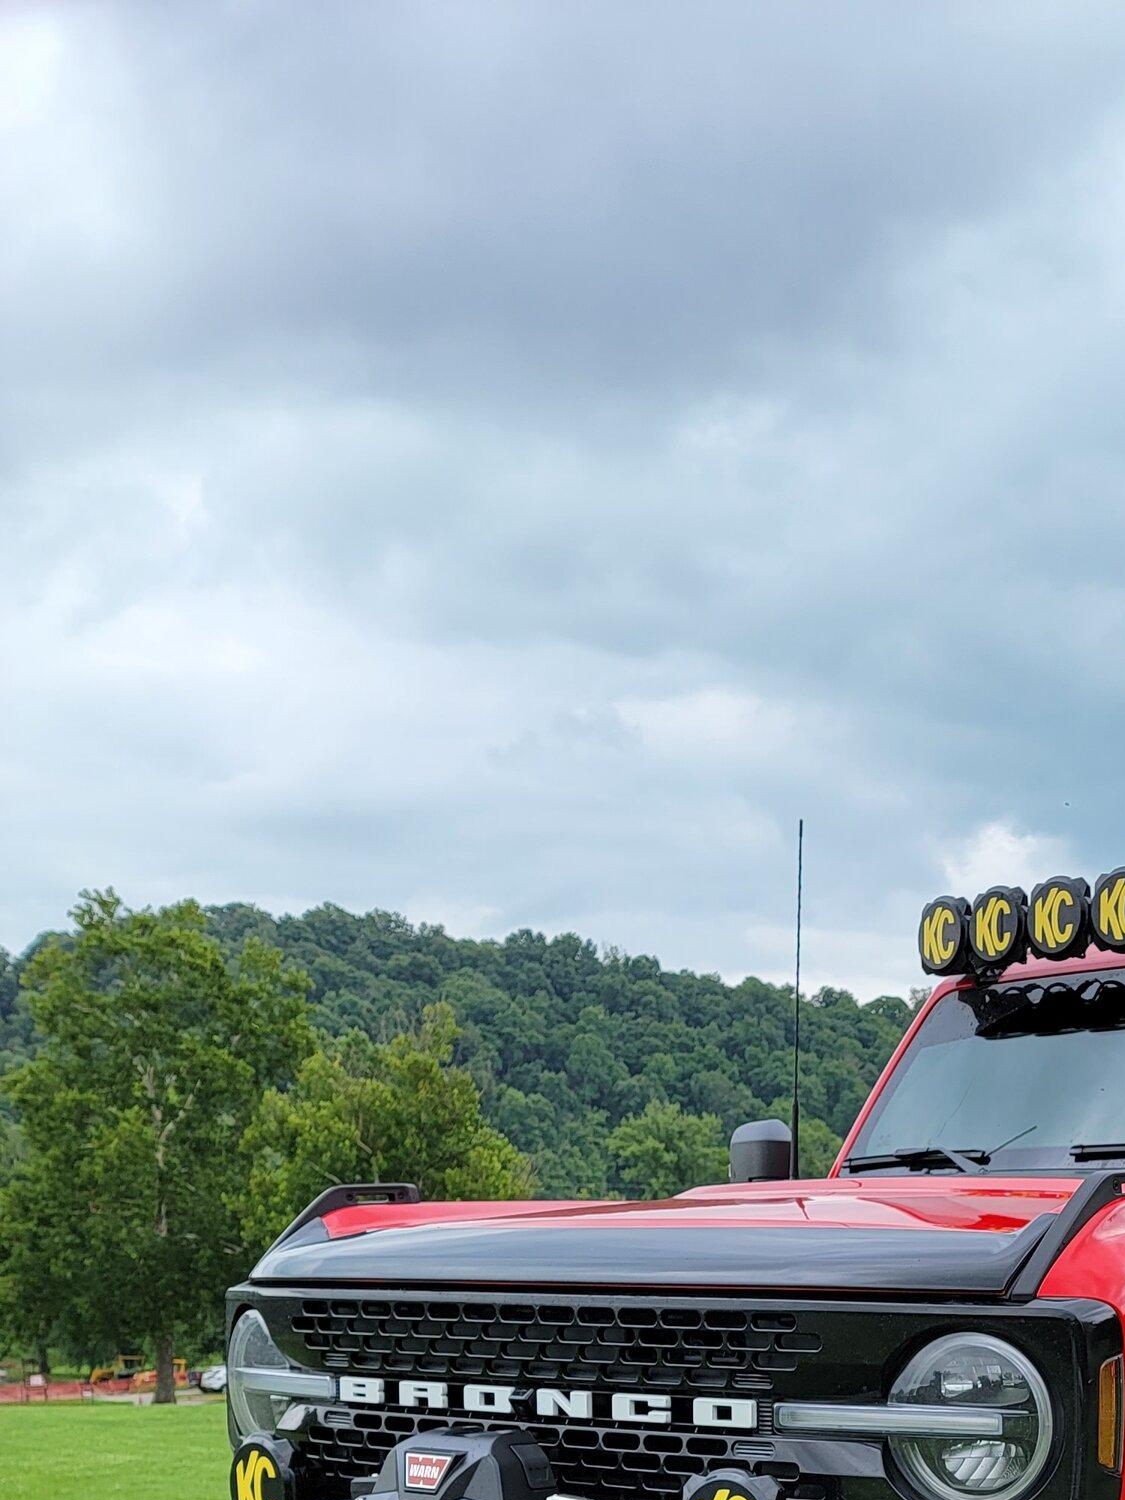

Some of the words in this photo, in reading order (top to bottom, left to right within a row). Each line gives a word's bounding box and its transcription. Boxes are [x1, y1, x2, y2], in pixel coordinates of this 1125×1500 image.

[923, 910, 954, 965] KC
[976, 900, 1010, 955] KC
[1036, 890, 1074, 947] KC
[339, 1375, 758, 1428] BRONCO
[409, 1463, 440, 1479] WARN
